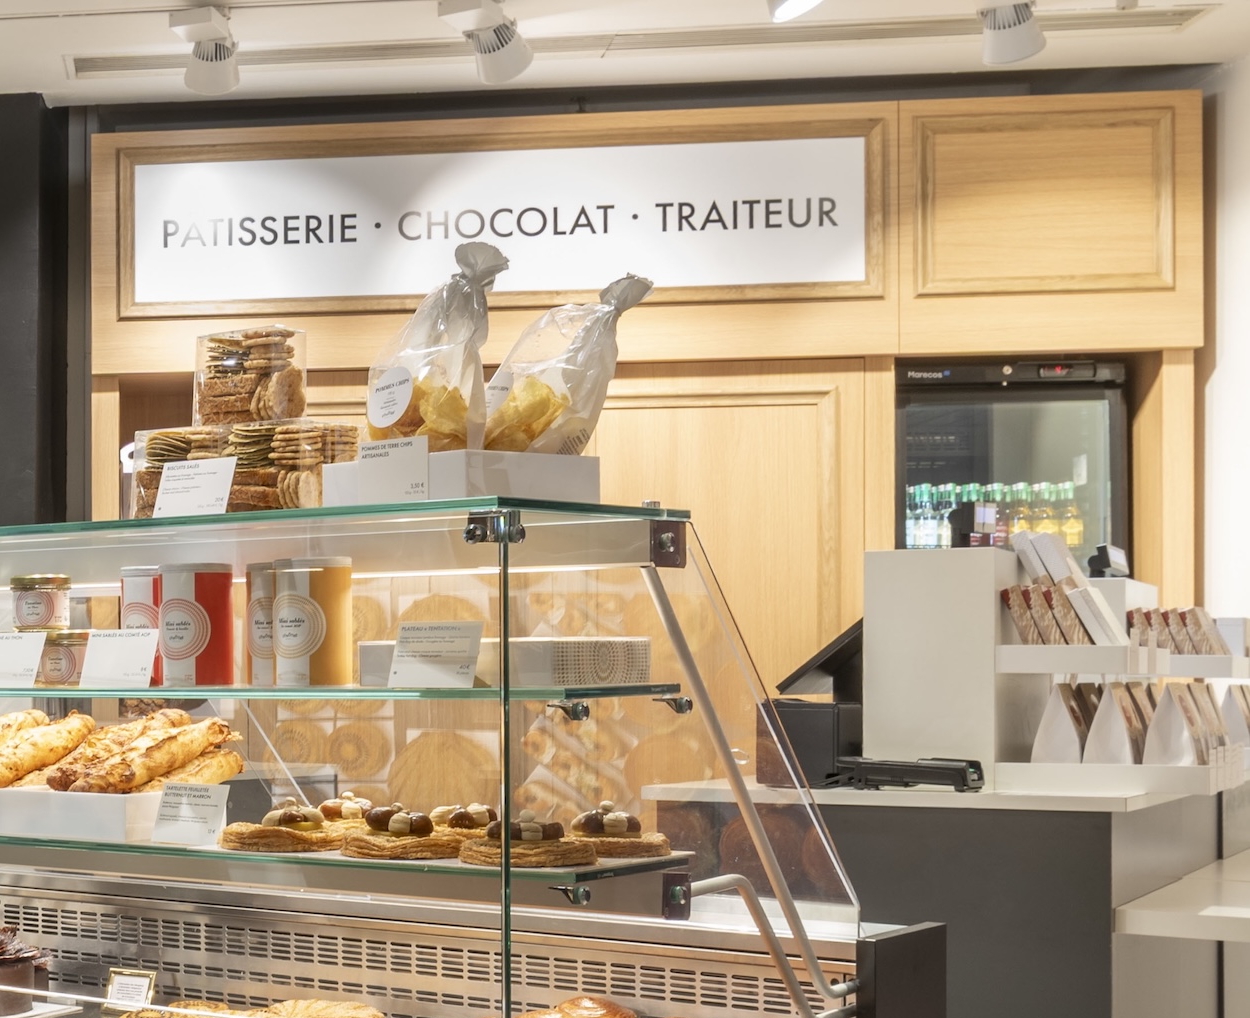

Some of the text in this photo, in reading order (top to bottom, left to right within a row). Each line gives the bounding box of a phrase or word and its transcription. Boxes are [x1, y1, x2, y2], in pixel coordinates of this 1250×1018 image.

[163, 197, 839, 248] PATISSERIE CHOCOLAT TRAITEUR
[907, 371, 943, 379] Marecos
[361, 444, 380, 452] POMMES
[361, 451, 390, 459] ARTISANALES
